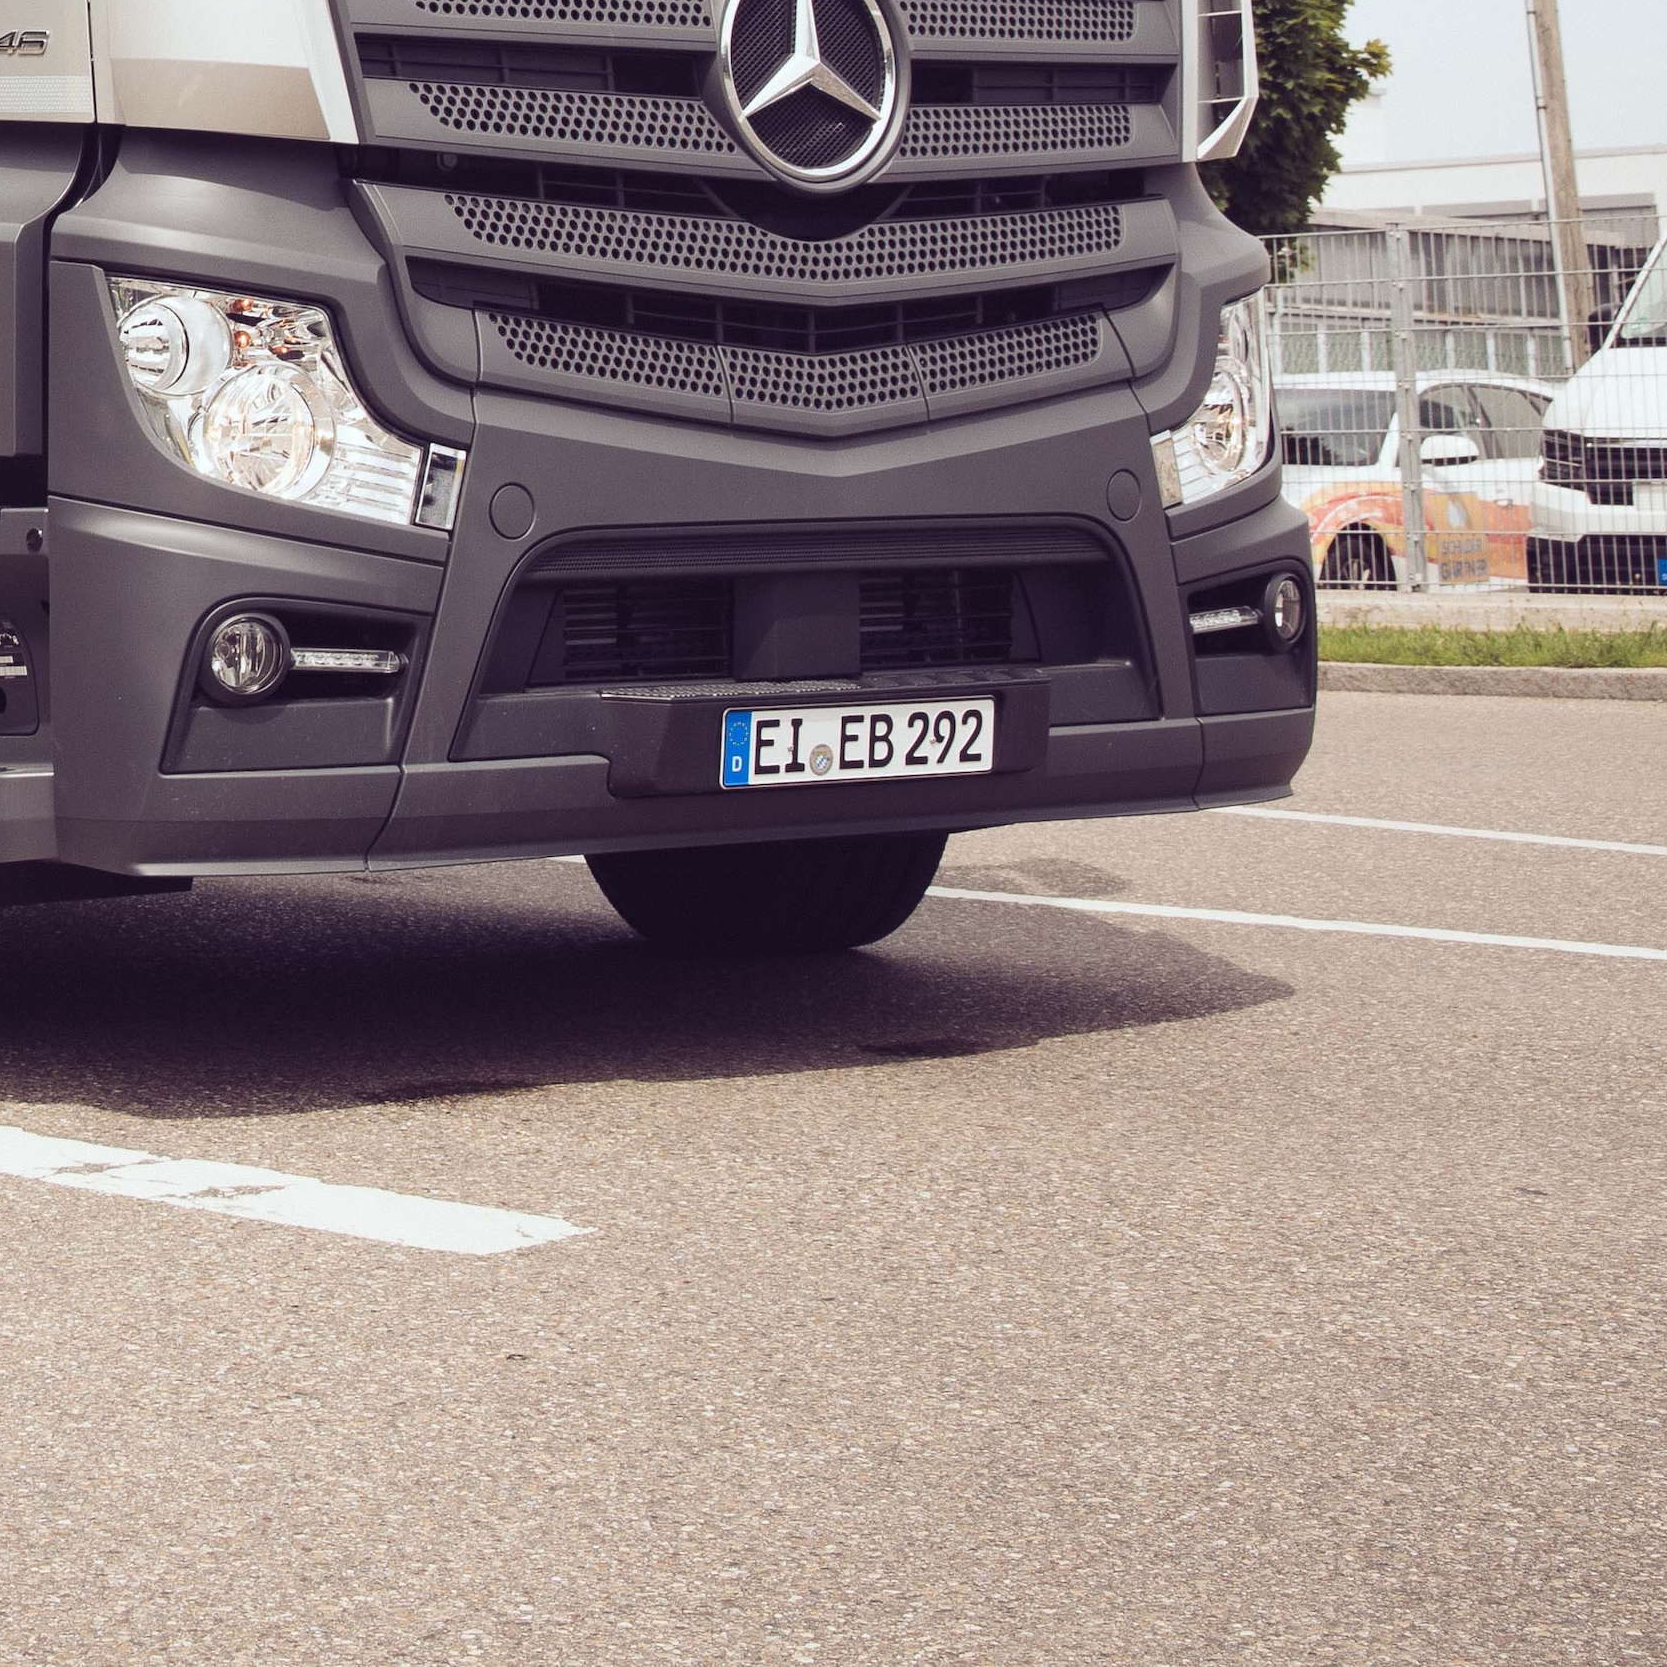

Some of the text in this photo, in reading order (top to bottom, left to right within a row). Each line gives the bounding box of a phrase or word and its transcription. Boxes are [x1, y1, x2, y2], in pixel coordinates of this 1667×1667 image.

[754, 708, 984, 775] EI EB 292
[731, 755, 743, 773] D
